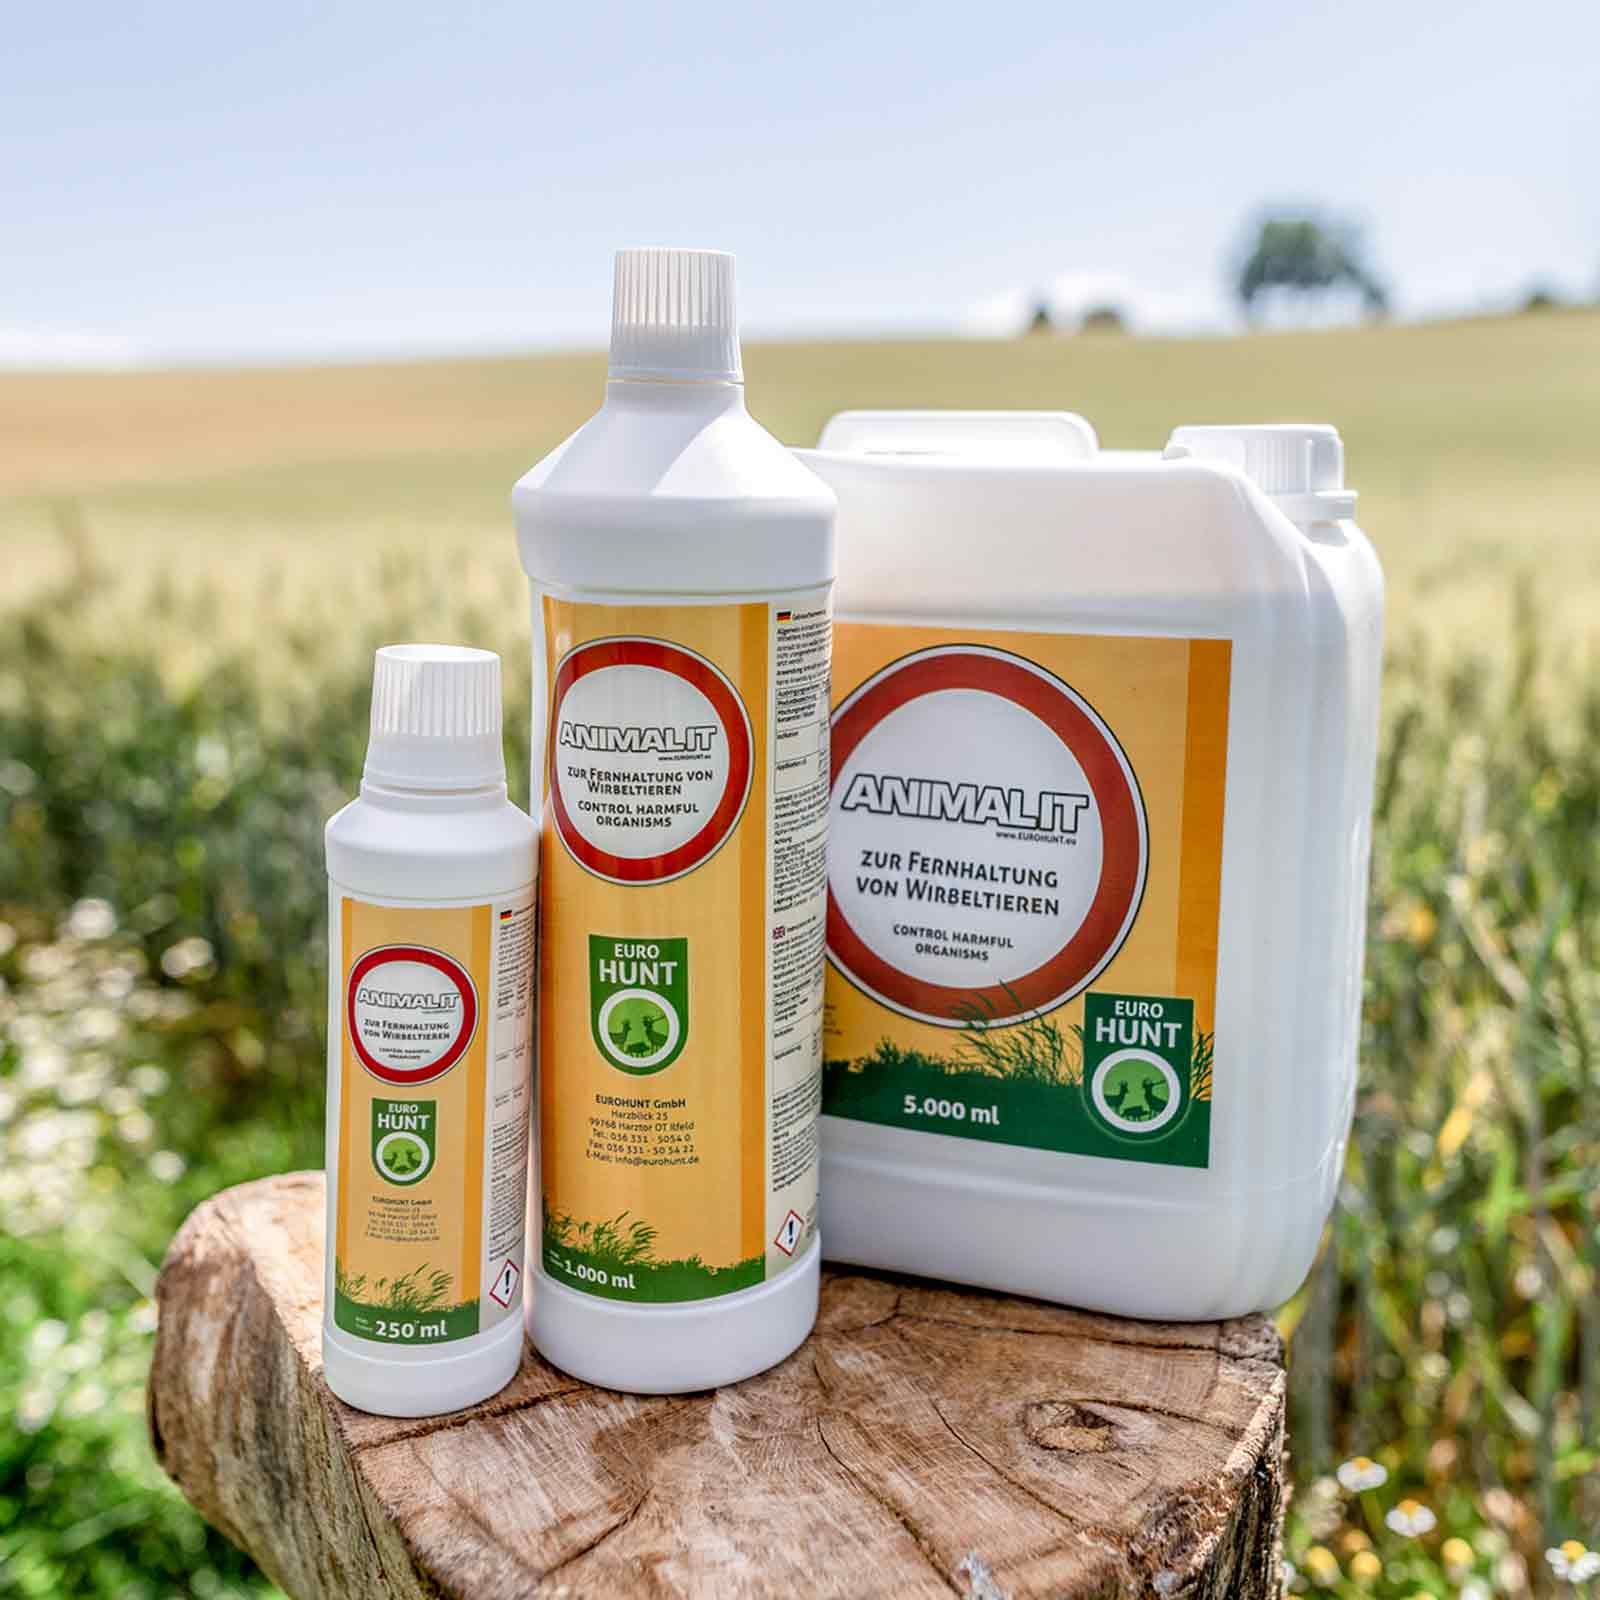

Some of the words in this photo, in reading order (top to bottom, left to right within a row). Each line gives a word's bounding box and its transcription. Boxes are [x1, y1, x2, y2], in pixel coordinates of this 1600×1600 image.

[559, 721, 717, 753] ANIMALIT
[567, 766, 587, 780] ZUR
[589, 767, 683, 783] FERNHALTUNG
[686, 770, 713, 782] VON
[587, 779, 682, 796] WIRBELTIEREN
[577, 800, 633, 815] CONTROL
[636, 803, 700, 815] HARMFUL
[841, 773, 1090, 834] ANIMALIT
[596, 815, 672, 828] ORGANISMS
[995, 831, 1077, 846] www.EUROHUNT.eu
[861, 849, 901, 872] ZUR
[908, 851, 1058, 888] FERNHALTUNG
[857, 876, 899, 898] VON
[905, 877, 1060, 916] WIRBELTIEREN
[893, 924, 949, 942] CONTROL
[952, 931, 1014, 949] HARMFUL
[614, 943, 660, 961] EURO
[915, 943, 989, 961] ORGANISMS
[599, 958, 678, 986] HUNT
[358, 988, 461, 1010] ANIMALIT
[1115, 1000, 1164, 1018] EURO
[1095, 1017, 1182, 1048] HUNT
[388, 1103, 418, 1114] EURO
[595, 1094, 651, 1109] EUROHUNT
[654, 1098, 686, 1109] GmbH
[903, 1095, 967, 1121] 5.000
[971, 1104, 1000, 1126] ml
[377, 1114, 431, 1131] HUNT
[564, 1260, 608, 1285] 1.000
[611, 1273, 636, 1289] ml
[375, 1320, 415, 1338] 250
[420, 1319, 448, 1338] ml
